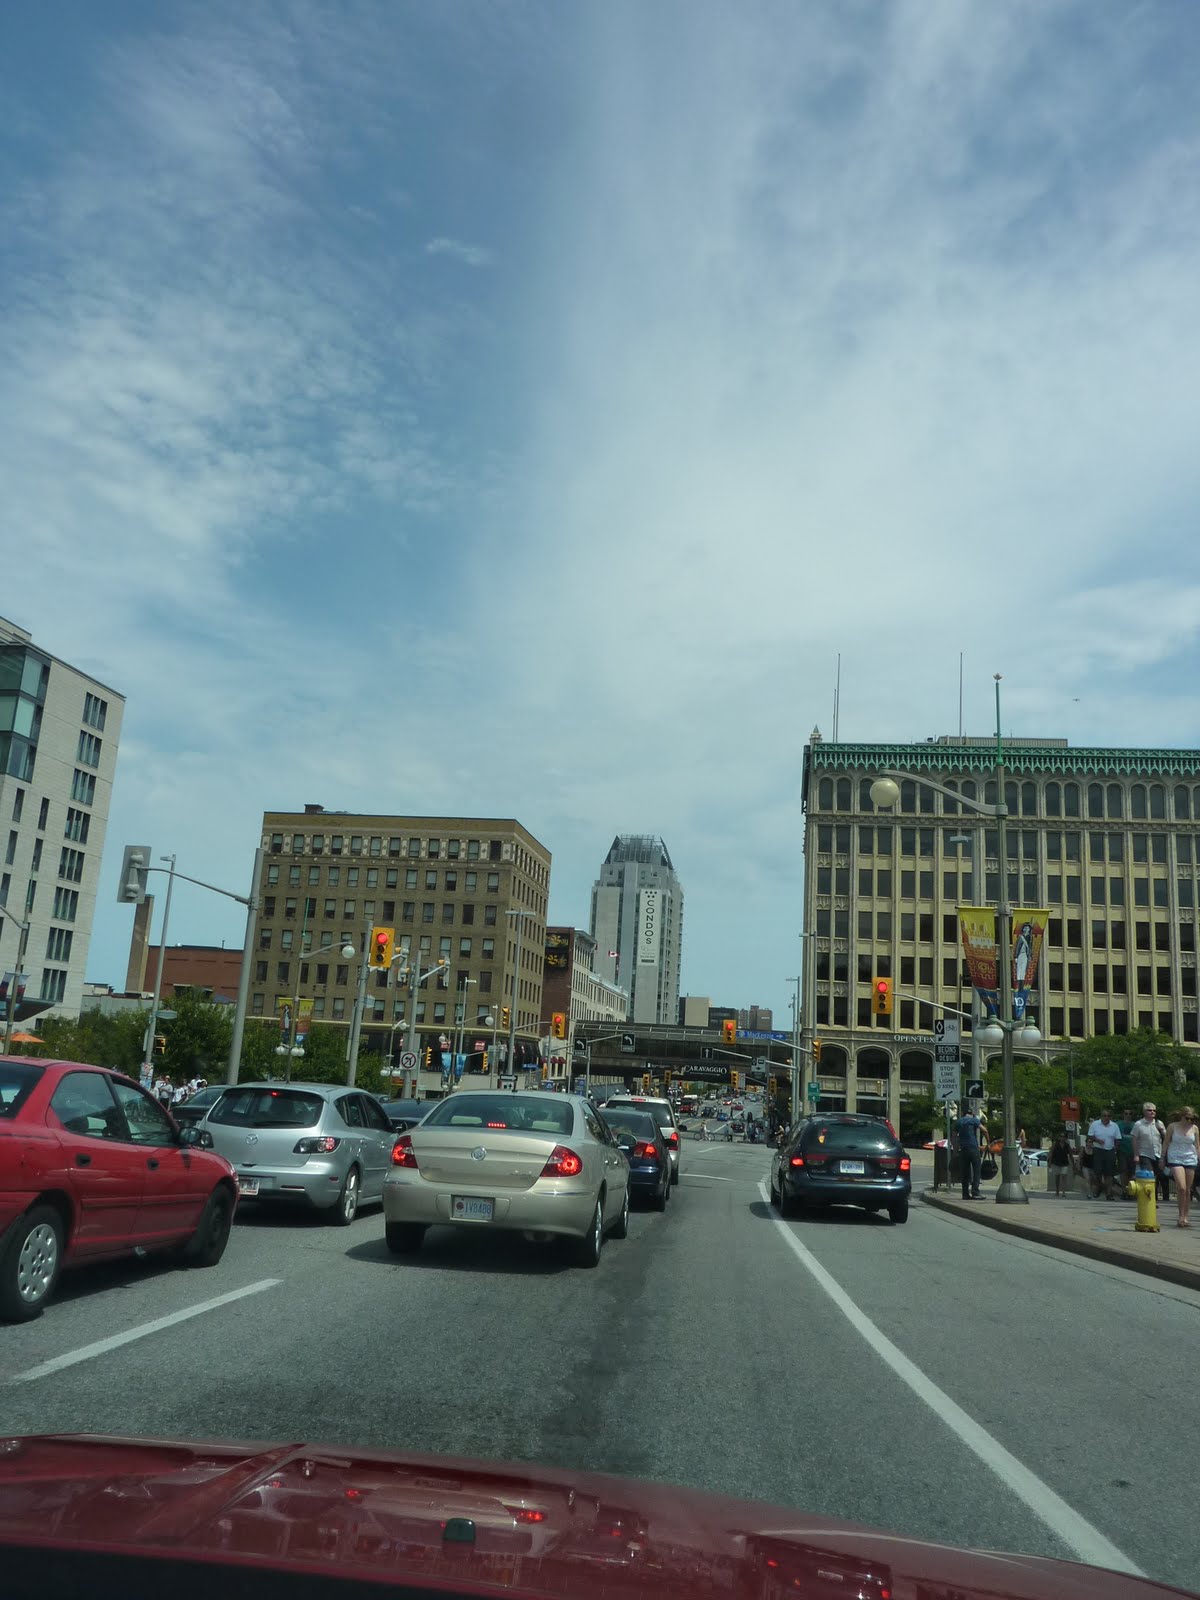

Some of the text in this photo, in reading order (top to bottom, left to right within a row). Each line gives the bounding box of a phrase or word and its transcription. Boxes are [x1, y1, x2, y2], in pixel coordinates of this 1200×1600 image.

[645, 899, 655, 945] CONDOS
[747, 1031, 774, 1039] MacKenzie
[893, 1034, 935, 1043] OPENTEX
[937, 1046, 957, 1054] BEGINS
[683, 1064, 728, 1074] CARAVAGGIO
